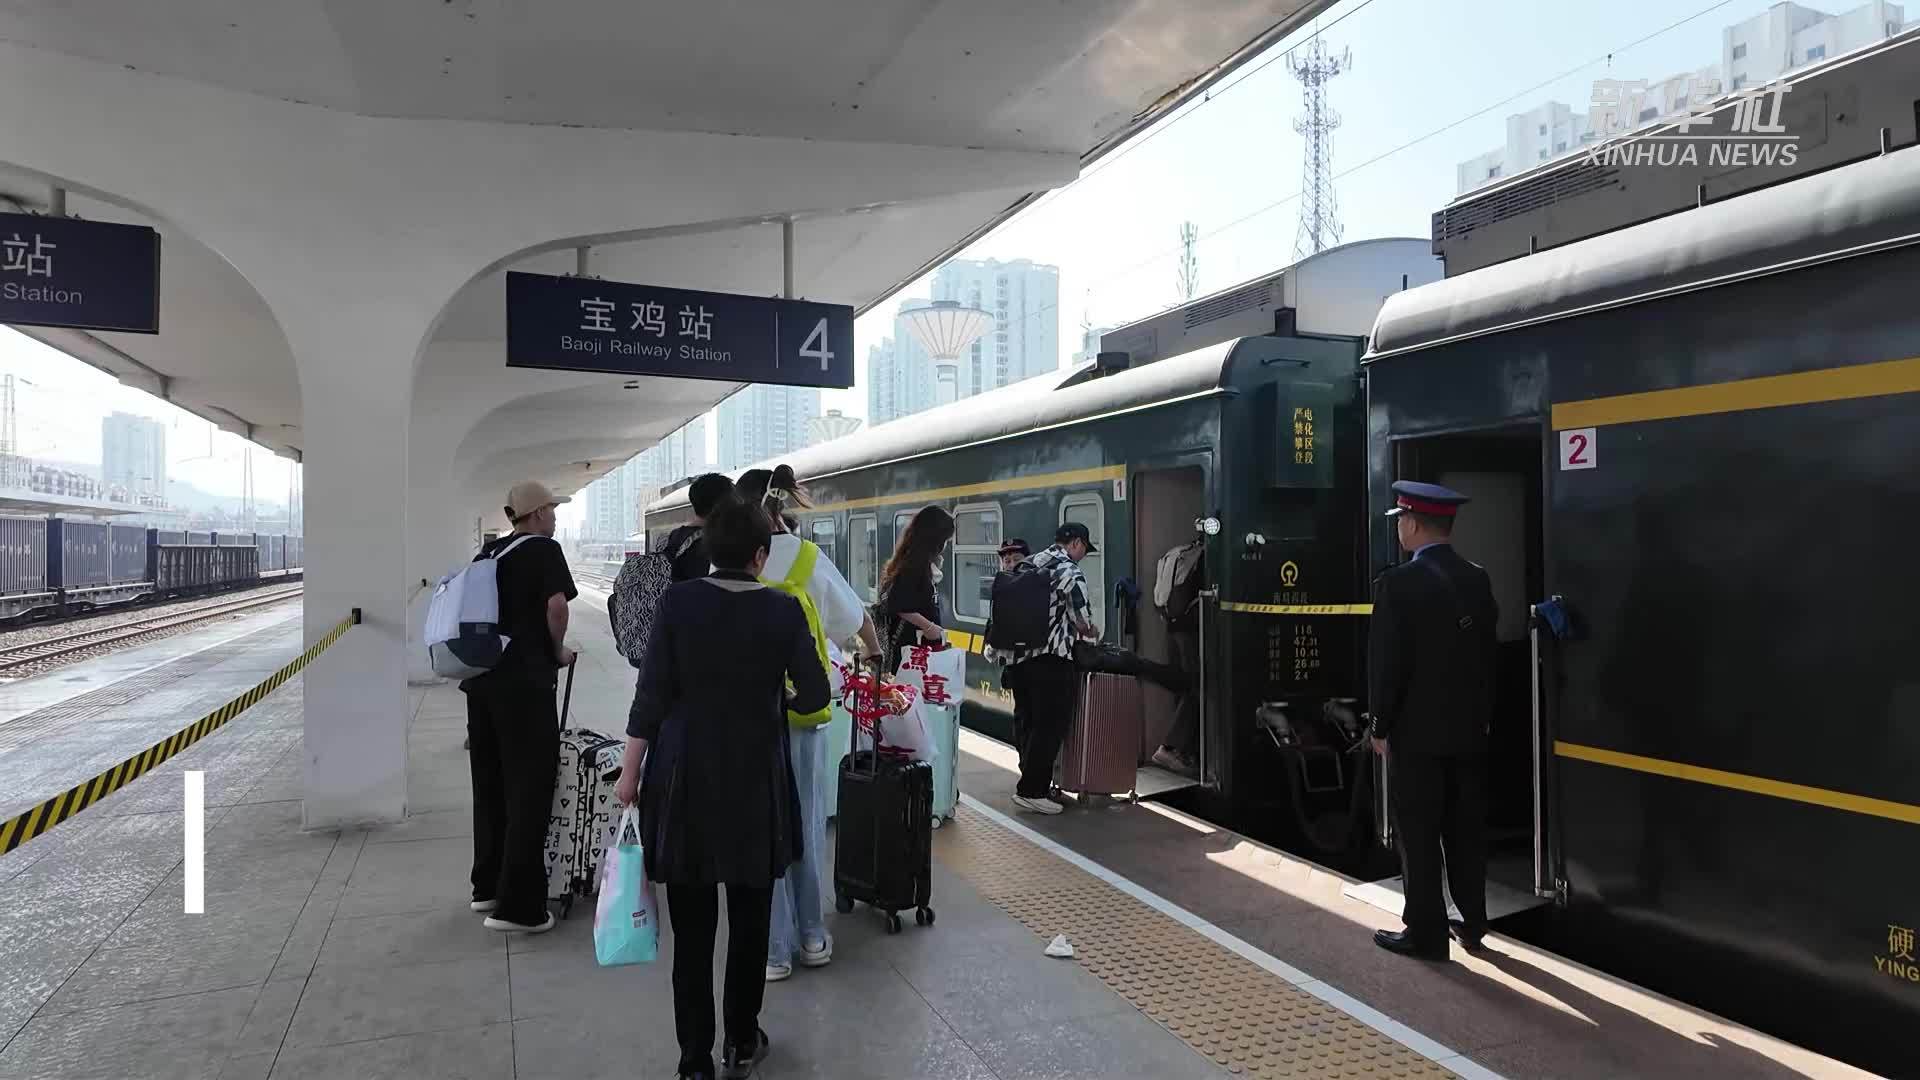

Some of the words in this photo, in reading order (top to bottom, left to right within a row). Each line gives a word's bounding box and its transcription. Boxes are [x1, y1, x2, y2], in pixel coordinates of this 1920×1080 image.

[3, 233, 57, 277] 站
[4, 282, 82, 304] Station
[580, 297, 714, 341] 宝鸡站
[561, 336, 602, 355] Baoji
[610, 339, 672, 360] Railway
[679, 345, 732, 361] Station
[799, 317, 835, 371] 4
[1569, 434, 1588, 465] 2
[1116, 480, 1122, 498] 1
[1888, 924, 1915, 961] 硬
[1874, 955, 1920, 982] YING
